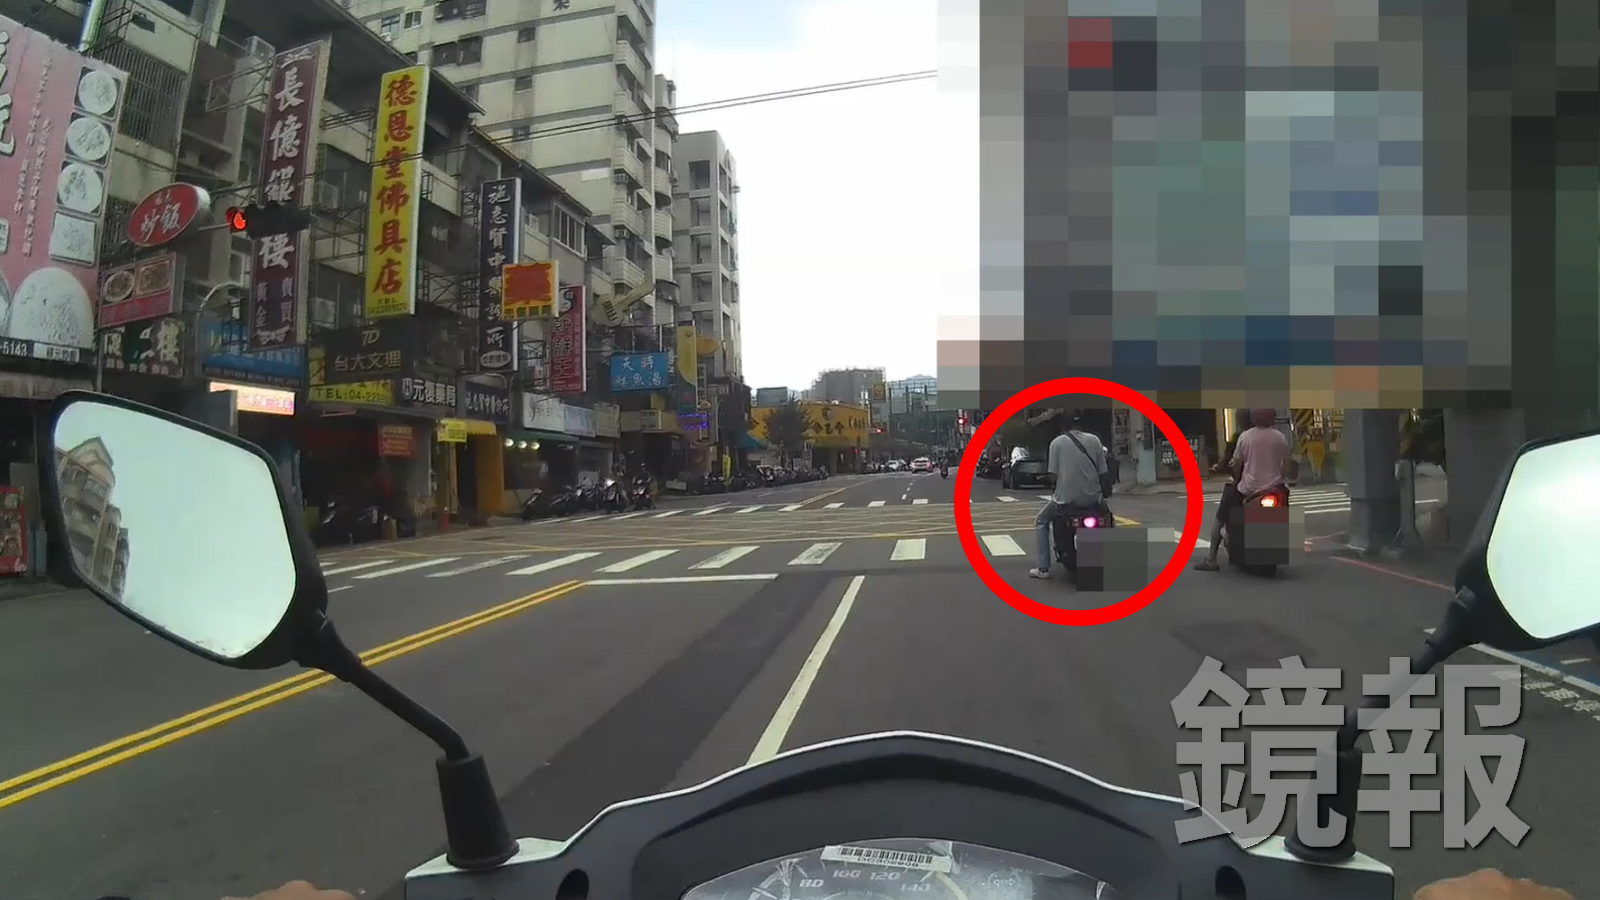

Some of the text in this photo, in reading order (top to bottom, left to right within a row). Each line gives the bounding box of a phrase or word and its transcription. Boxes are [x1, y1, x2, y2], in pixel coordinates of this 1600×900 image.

[372, 74, 417, 296] 德恩堂佛具店
[140, 202, 181, 242] 炒飯
[334, 350, 402, 371] 台大文理
[622, 355, 656, 372] 天時
[413, 379, 456, 406] 元復藥局
[832, 870, 861, 878] 100
[869, 871, 901, 881] 120
[799, 879, 825, 888] 80
[900, 883, 931, 891] 140
